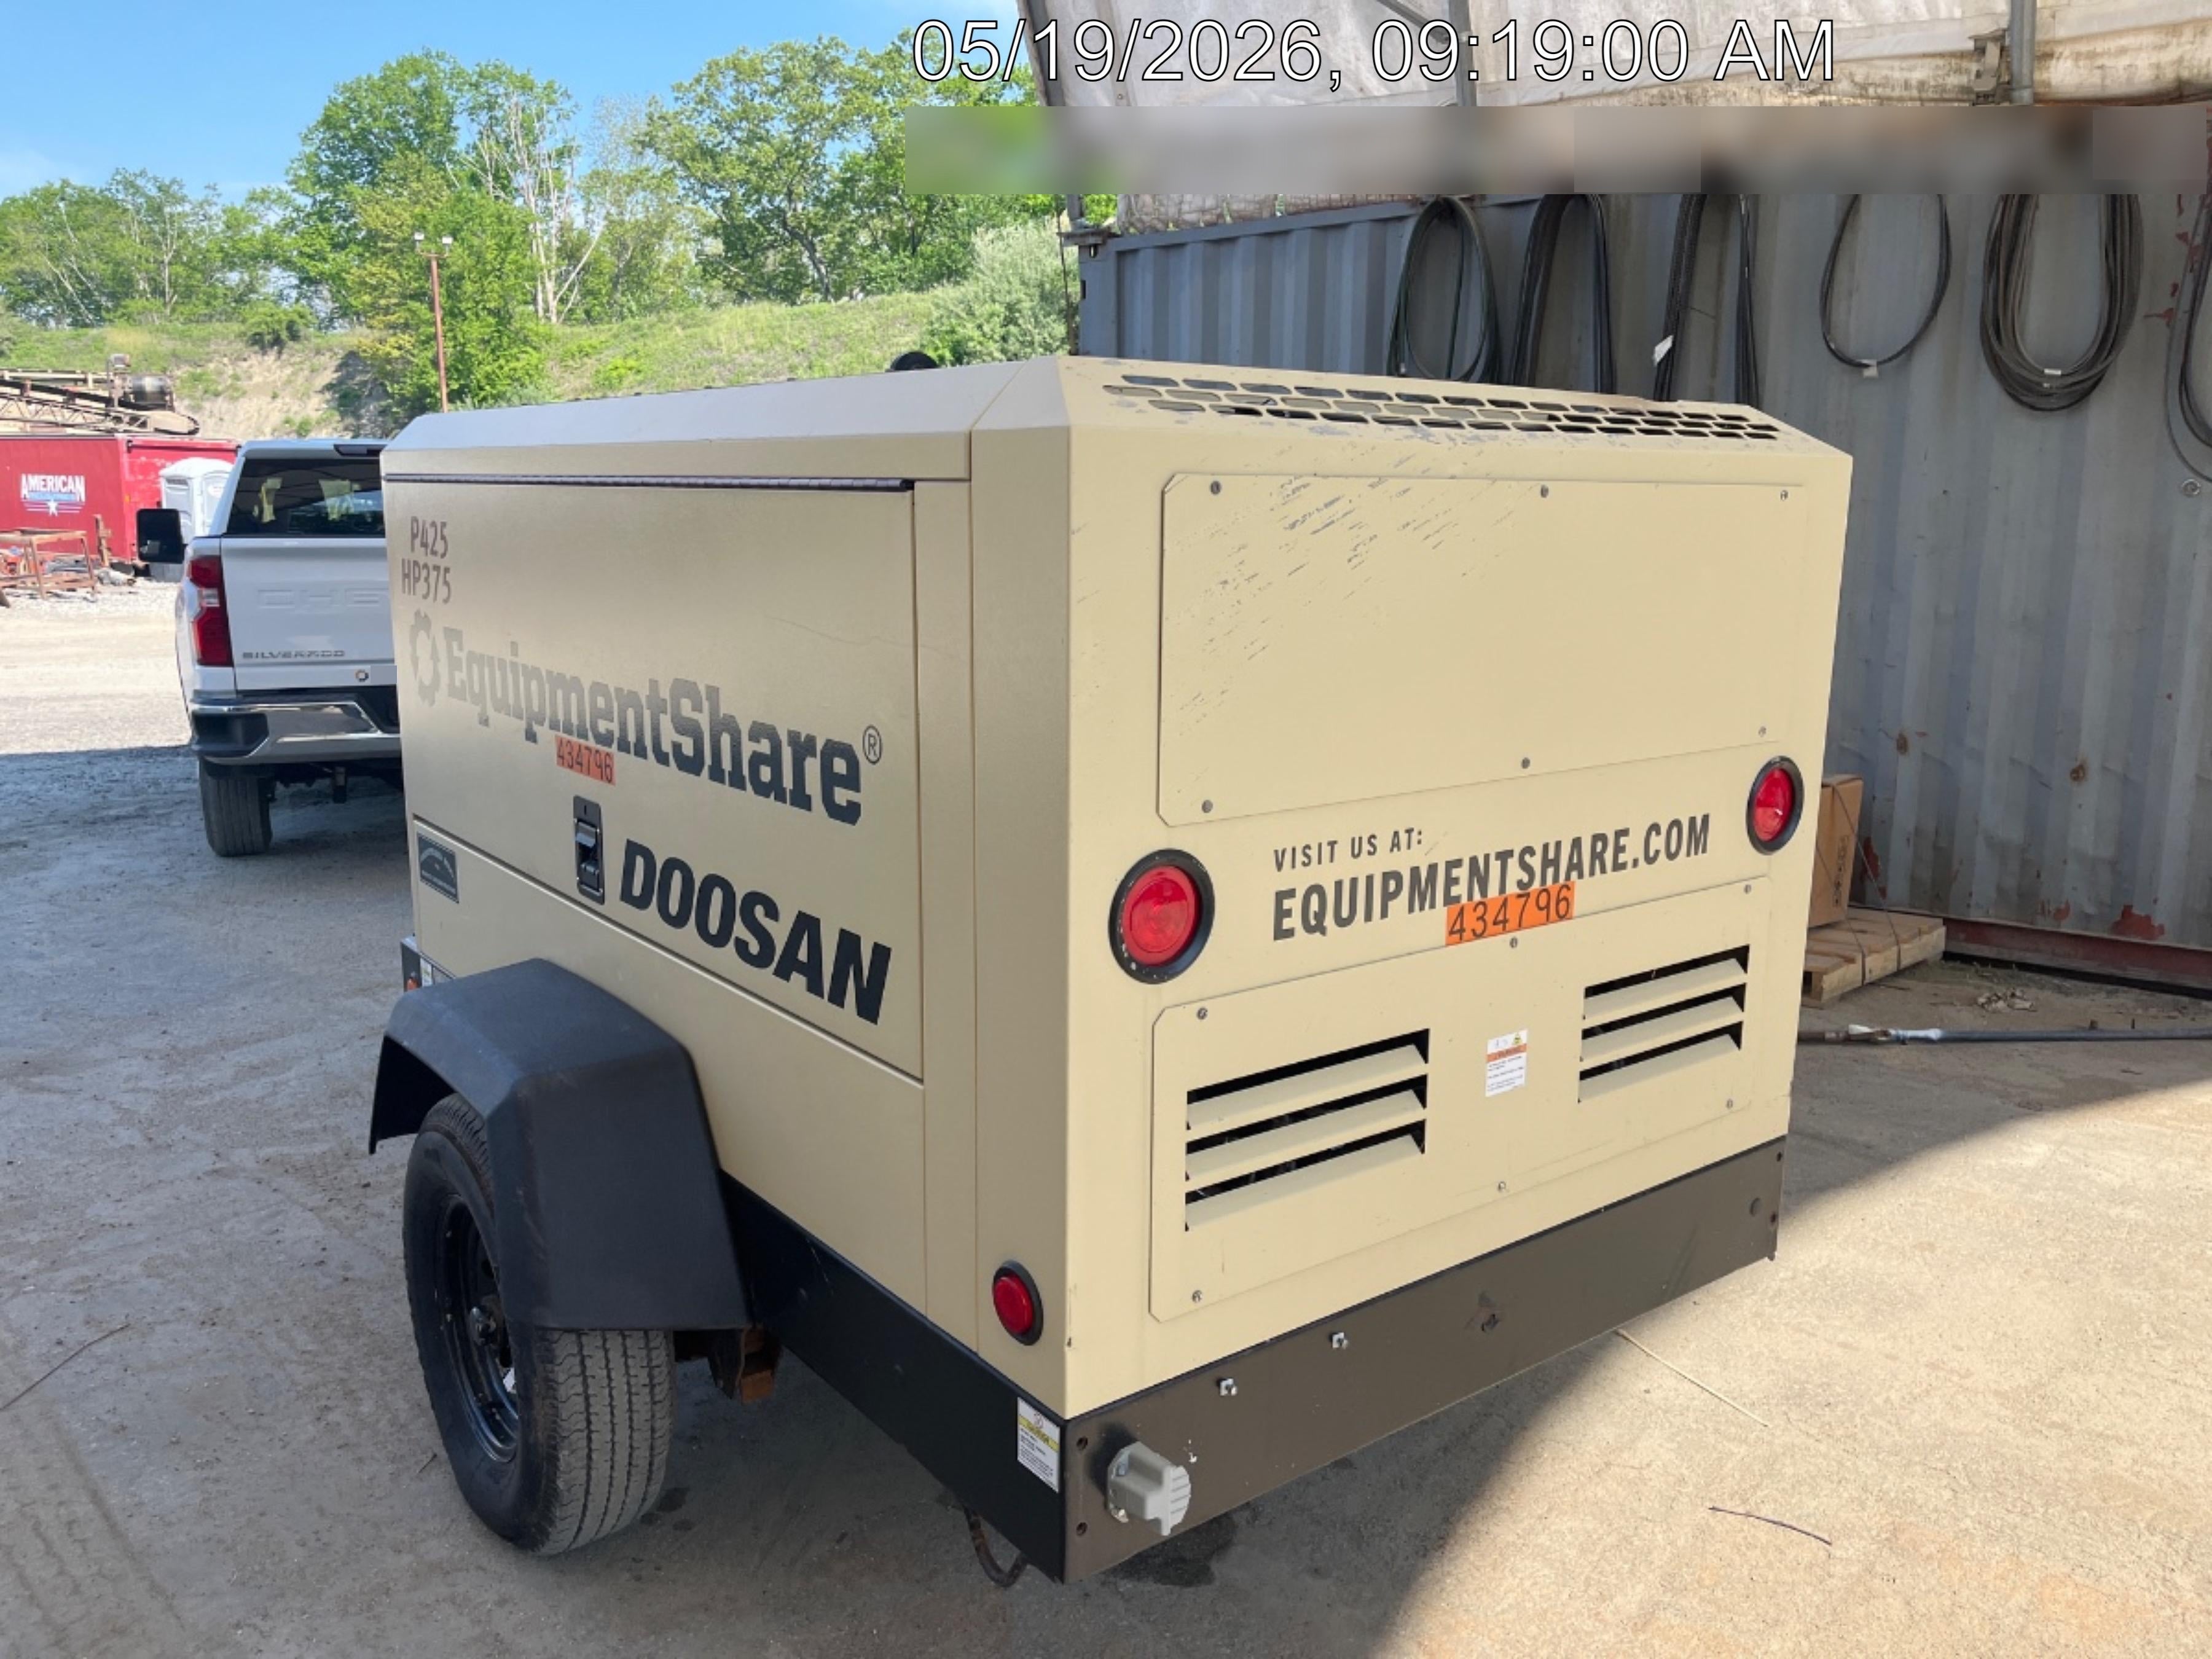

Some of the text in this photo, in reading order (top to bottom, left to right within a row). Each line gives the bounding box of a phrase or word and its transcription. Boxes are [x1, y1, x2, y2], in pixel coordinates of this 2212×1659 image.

[20, 473, 85, 501] AMERICAN
[410, 516, 448, 559] P425
[401, 558, 451, 604] HP375
[1274, 828, 1422, 873] VISIT US AT:
[1273, 814, 1710, 941] EQUIPMENTSHARE.COM
[619, 838, 892, 1026] DOOSAN
[1448, 884, 1571, 941] 434796
